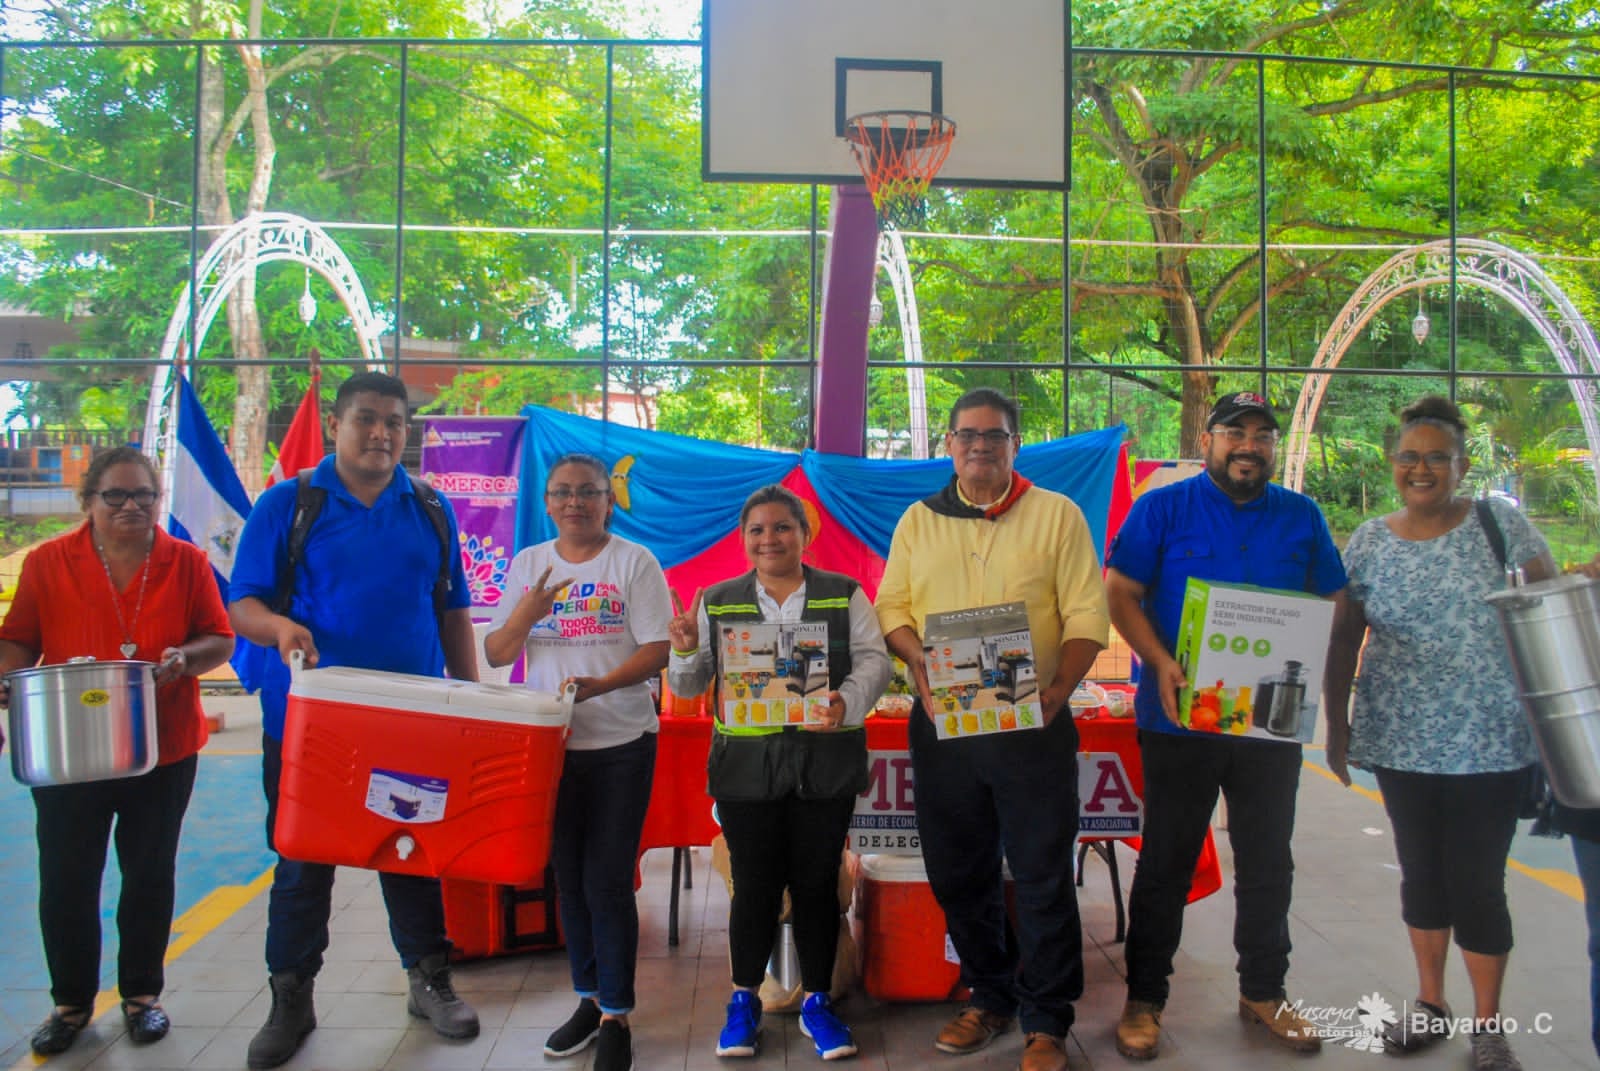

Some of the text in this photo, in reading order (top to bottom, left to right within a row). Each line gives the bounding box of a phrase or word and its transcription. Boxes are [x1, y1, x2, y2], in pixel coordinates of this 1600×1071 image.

[1266, 607, 1278, 616] DE
[559, 615, 597, 629] TODOS
[560, 624, 607, 638] JUNTOS!
[878, 815, 889, 828] DE
